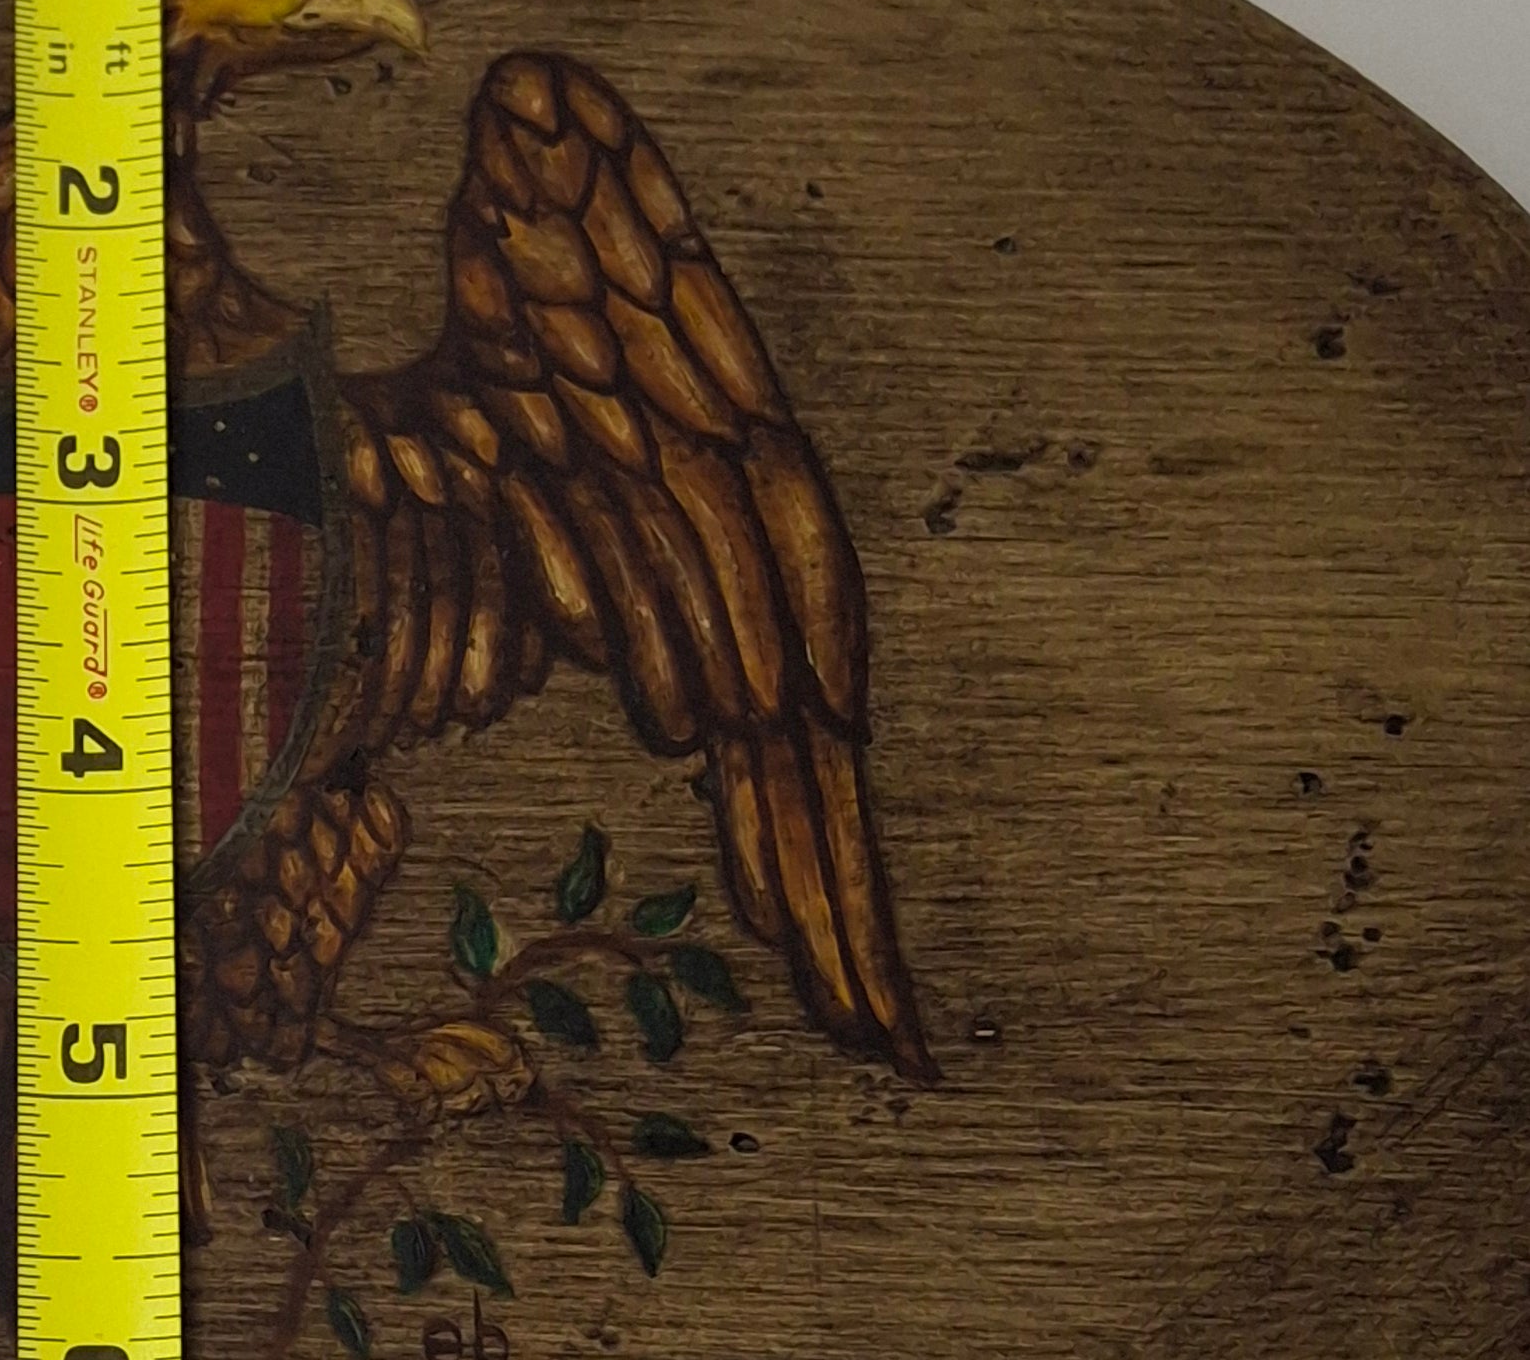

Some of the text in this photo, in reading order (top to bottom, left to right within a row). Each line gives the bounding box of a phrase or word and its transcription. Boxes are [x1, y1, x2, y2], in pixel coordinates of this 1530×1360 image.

[47, 41, 75, 74] in
[104, 41, 130, 75] ft
[58, 165, 120, 216] 2
[57, 435, 121, 490] 3
[60, 717, 124, 778] 4
[61, 1022, 128, 1085] 5
